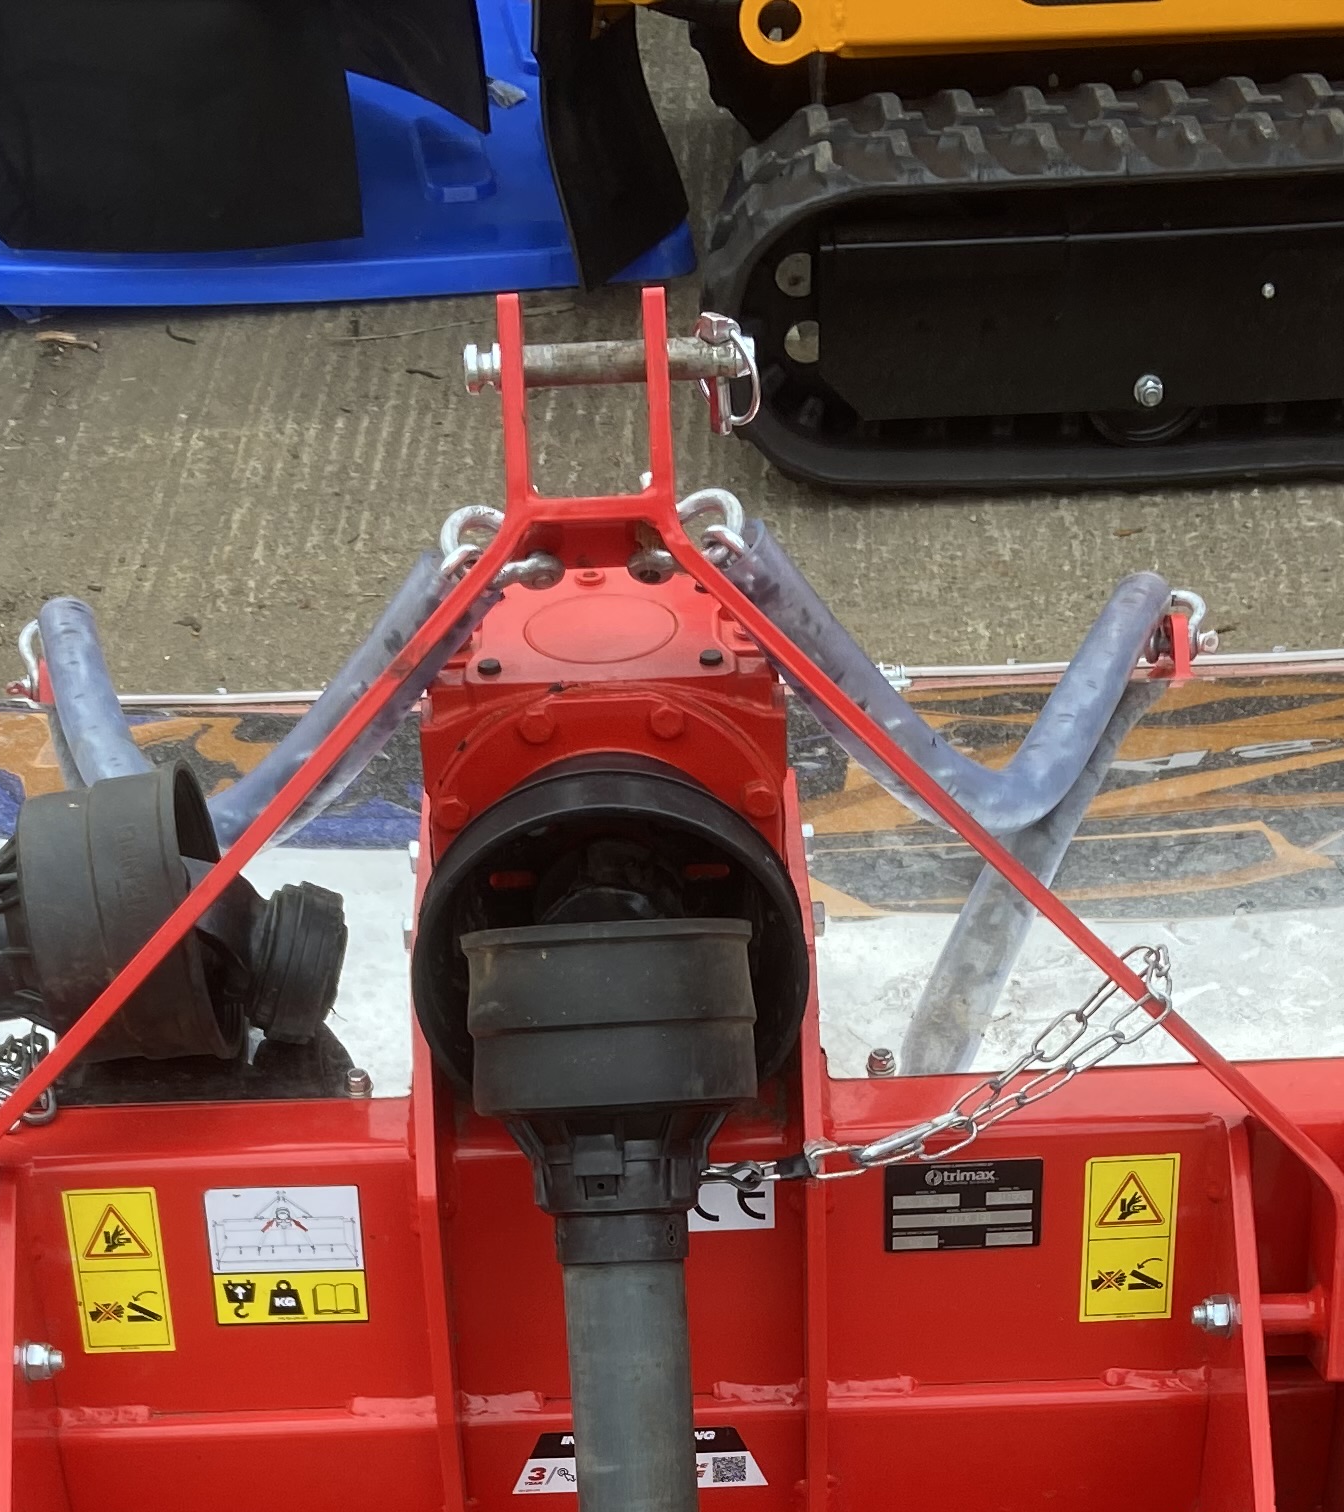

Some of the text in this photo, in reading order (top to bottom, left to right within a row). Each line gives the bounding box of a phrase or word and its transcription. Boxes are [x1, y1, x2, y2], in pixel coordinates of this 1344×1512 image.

[943, 1169, 996, 1182] trimax
[273, 1296, 297, 1307] KG
[527, 1466, 546, 1481] 3
